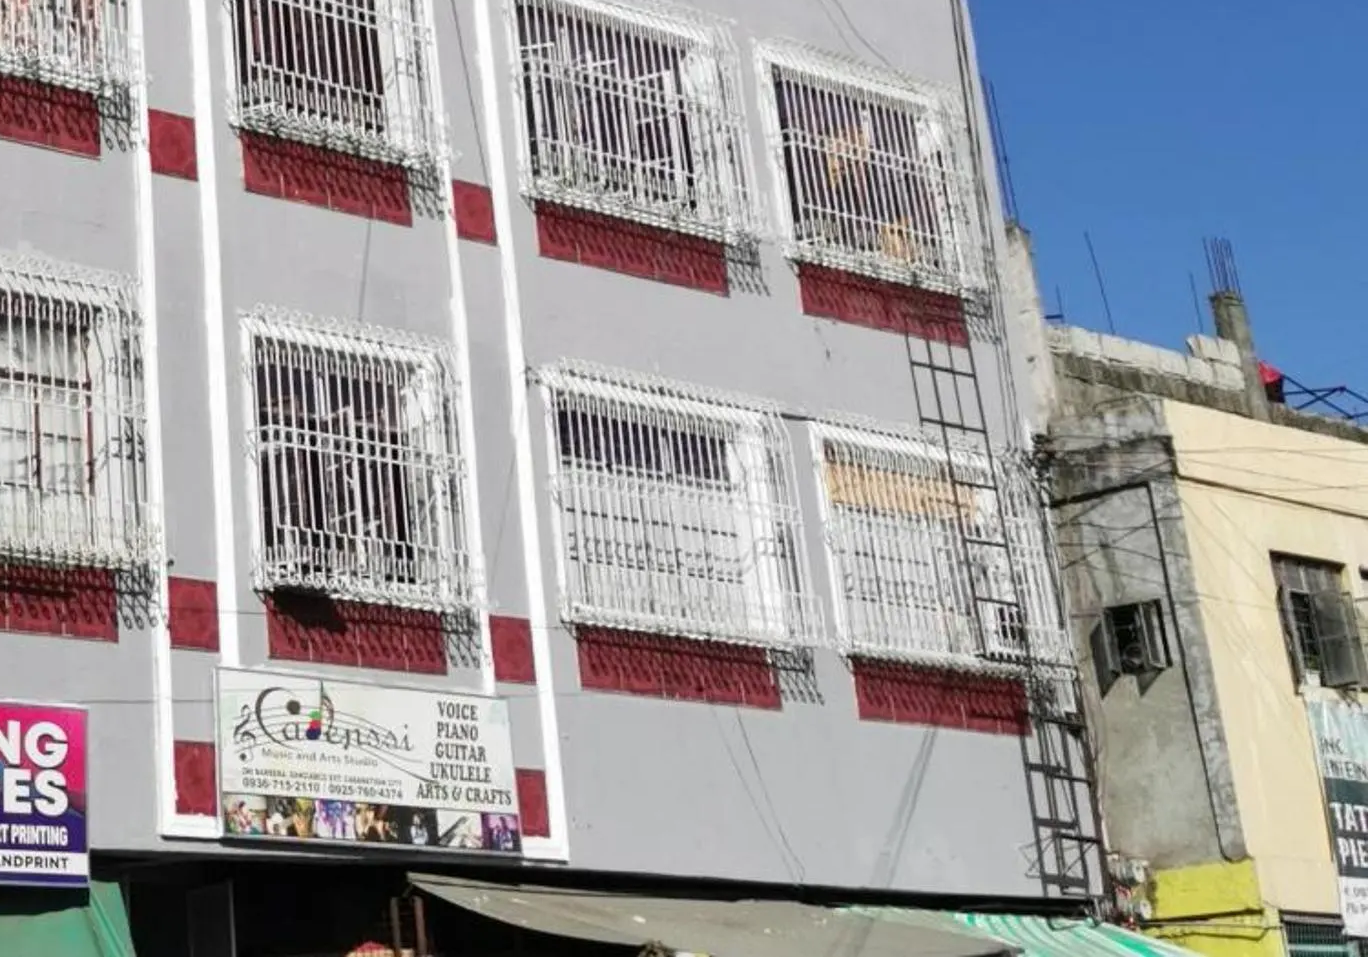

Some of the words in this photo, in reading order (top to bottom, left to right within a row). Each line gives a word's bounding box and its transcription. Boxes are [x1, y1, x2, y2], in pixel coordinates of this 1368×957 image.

[437, 701, 478, 721] VOICE
[436, 721, 479, 742] PIANO
[296, 751, 316, 761] and
[319, 753, 340, 764] Arts
[434, 742, 486, 762] GUITAR
[430, 762, 492, 784] UKULELE
[416, 782, 448, 801] ARTS
[452, 786, 462, 801] &
[466, 787, 512, 806] CRAFTS
[11, 824, 69, 846] PRINTING
